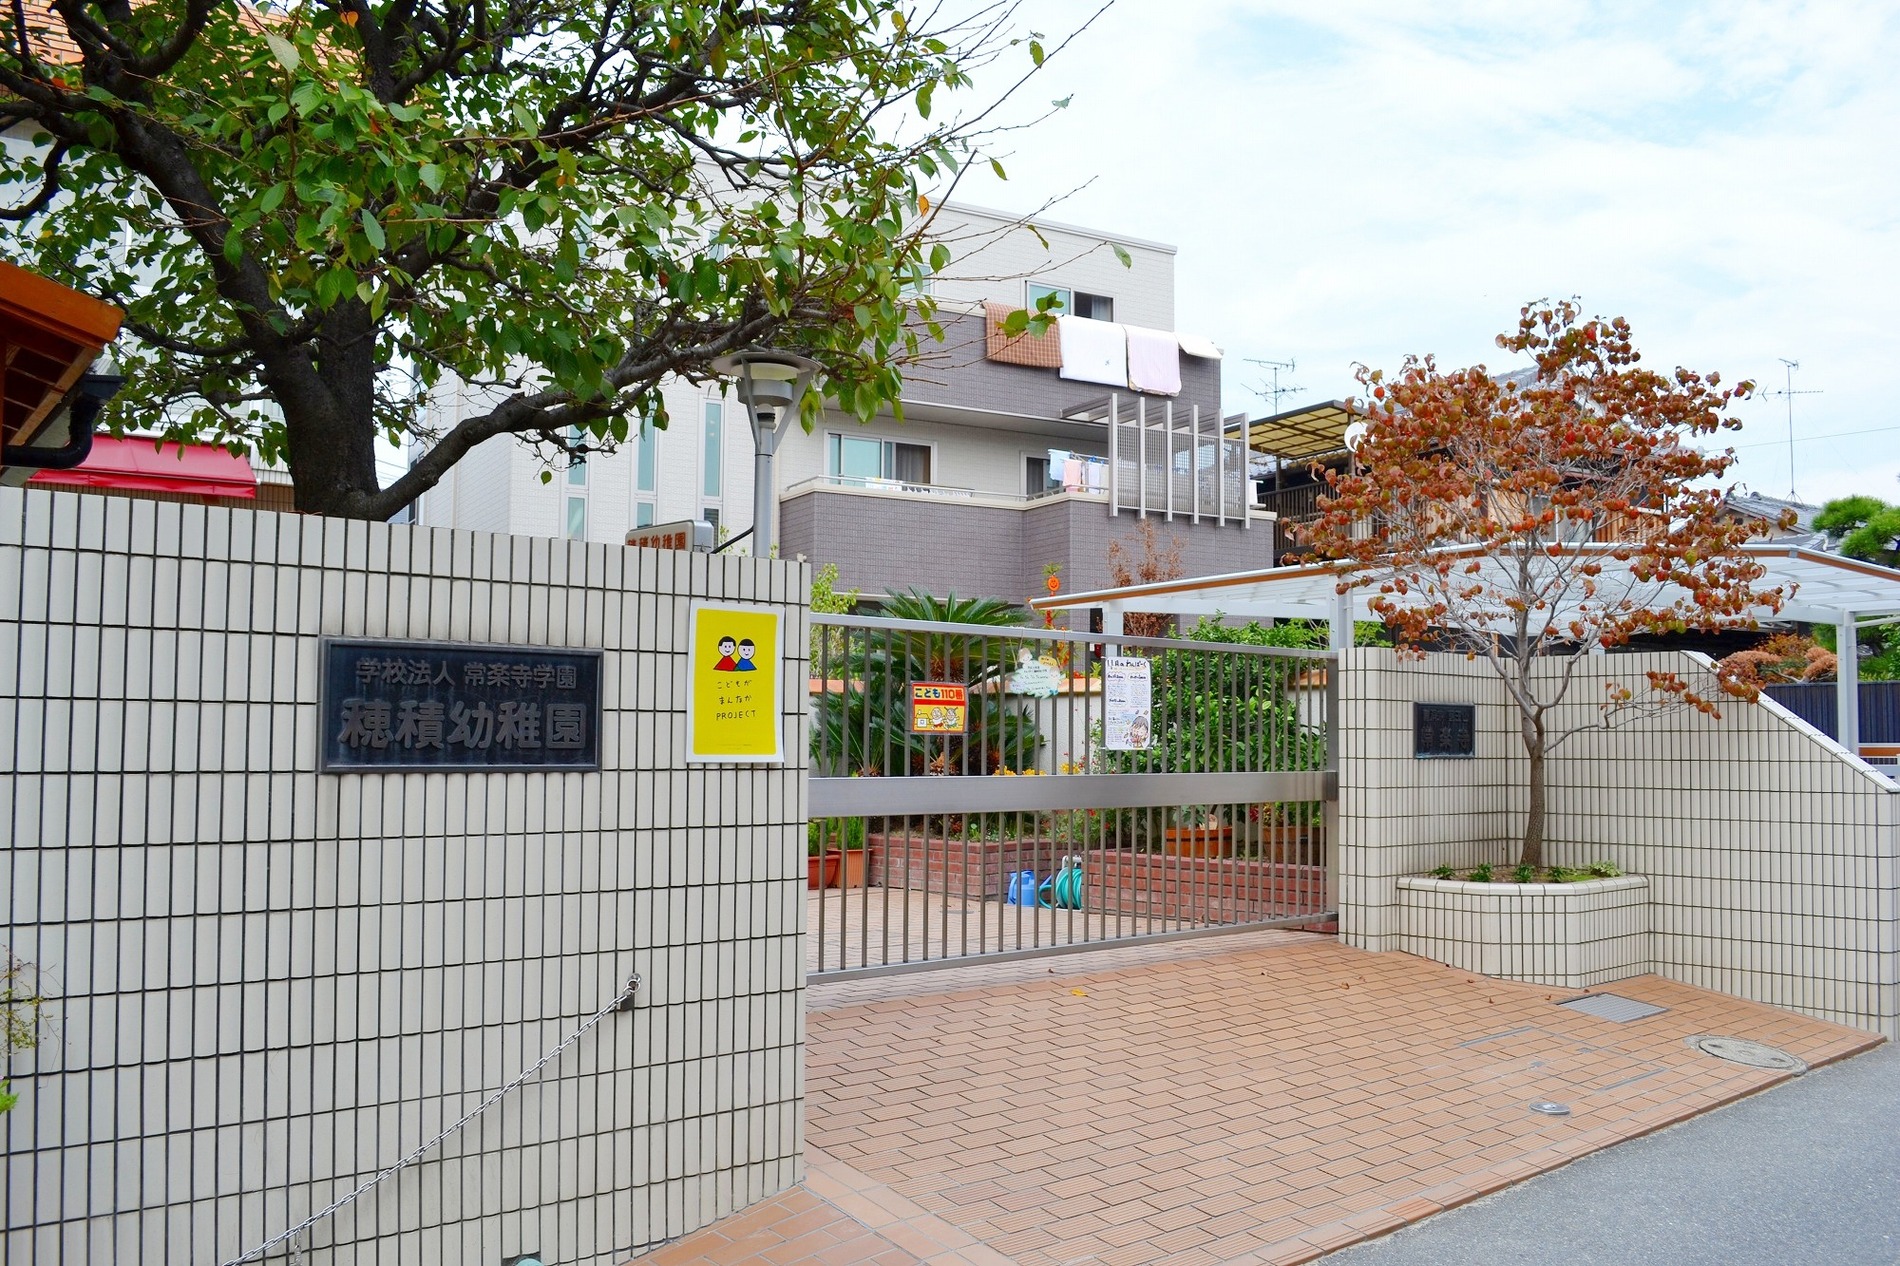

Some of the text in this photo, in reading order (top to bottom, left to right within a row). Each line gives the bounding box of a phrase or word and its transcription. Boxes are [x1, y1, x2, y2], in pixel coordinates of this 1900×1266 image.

[356, 657, 577, 690] 学校法人 常楽寺学園
[717, 680, 752, 690] こどもが
[915, 688, 963, 700] こども110番
[719, 695, 752, 705] まんなか
[716, 710, 756, 721] PROJECT
[338, 698, 586, 750] 穂積幼稚園
